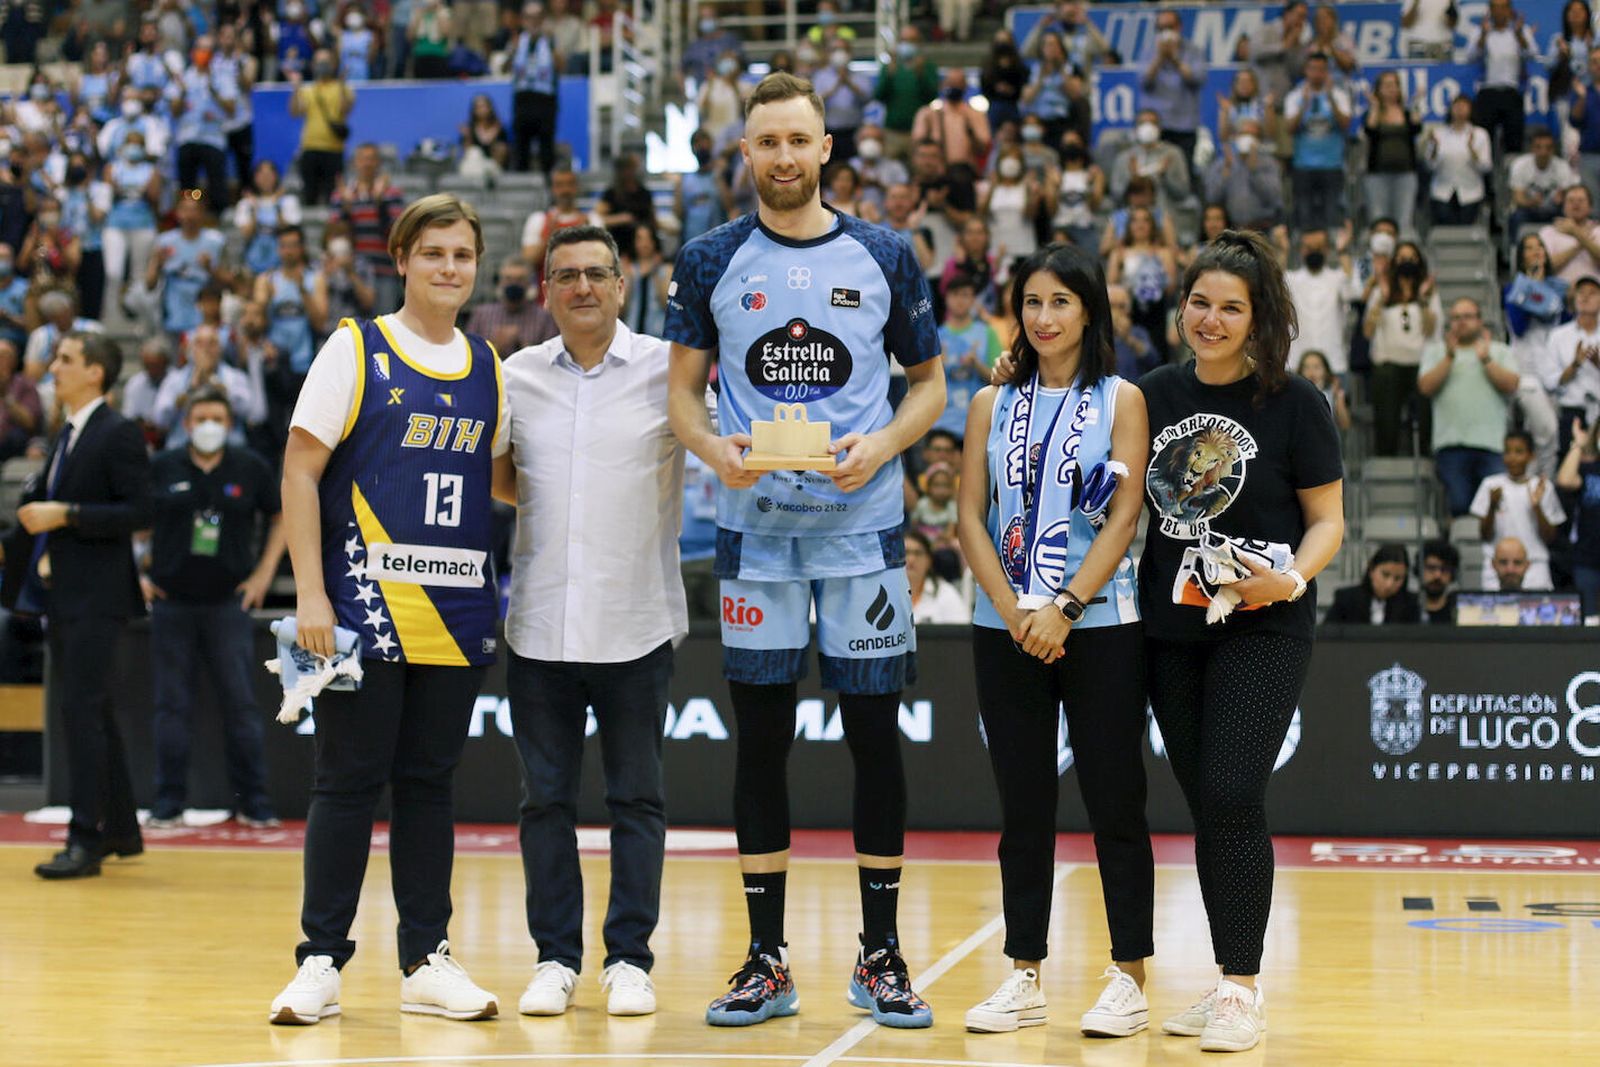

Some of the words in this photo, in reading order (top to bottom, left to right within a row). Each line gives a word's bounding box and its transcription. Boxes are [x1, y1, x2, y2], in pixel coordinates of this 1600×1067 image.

[760, 342, 835, 362] Estrella
[762, 361, 831, 382] Galicia
[401, 412, 485, 454] BIH
[1157, 415, 1255, 452] EMBREOGADOS
[423, 472, 464, 527] 13
[776, 501, 823, 513] Xacobeo
[824, 503, 848, 513] 21-22
[1163, 519, 1180, 536] BL
[381, 553, 478, 577] telemach
[848, 632, 906, 651] CANDELAS
[1429, 692, 1558, 714] DEPUTACIÓN
[1429, 716, 1457, 735] DE
[1459, 715, 1560, 749] LUGO
